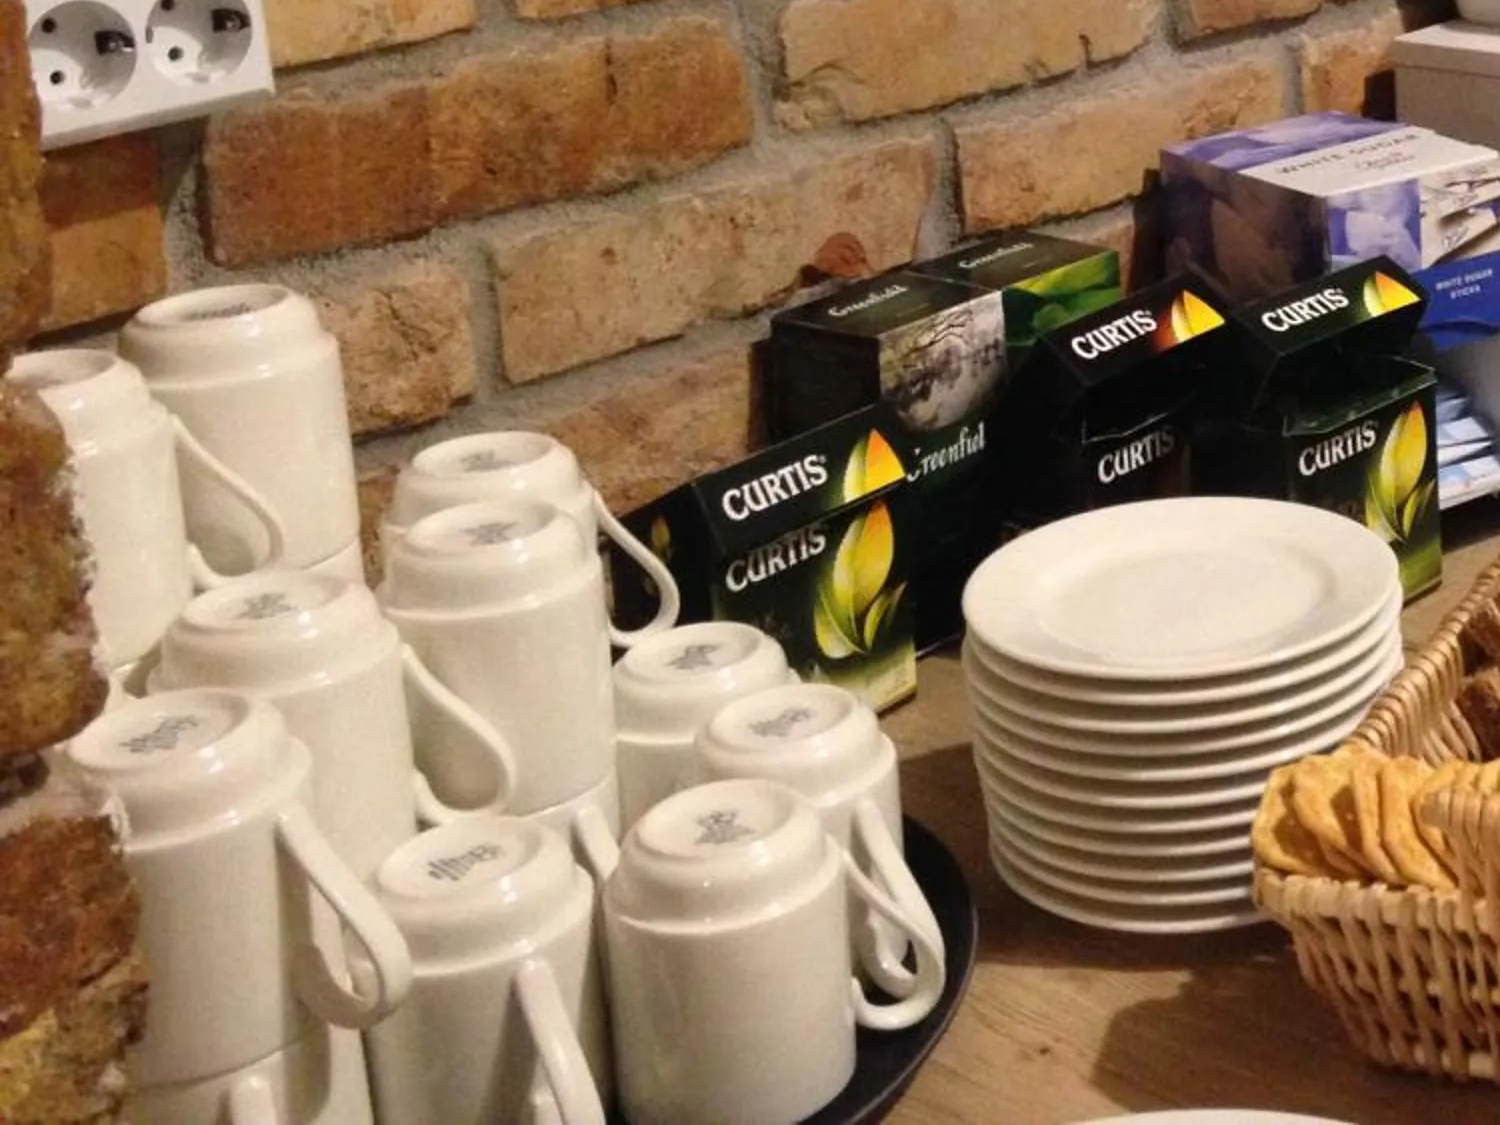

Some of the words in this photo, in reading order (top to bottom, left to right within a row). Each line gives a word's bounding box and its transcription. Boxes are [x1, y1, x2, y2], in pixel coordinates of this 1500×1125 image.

[1071, 309, 1158, 360] CURTIS
[1261, 287, 1350, 332] CURTIS
[1098, 423, 1176, 484] CURTIS
[1299, 419, 1378, 476] CURTIS
[722, 454, 829, 521] CURTIS
[725, 525, 827, 593] CURTIS
